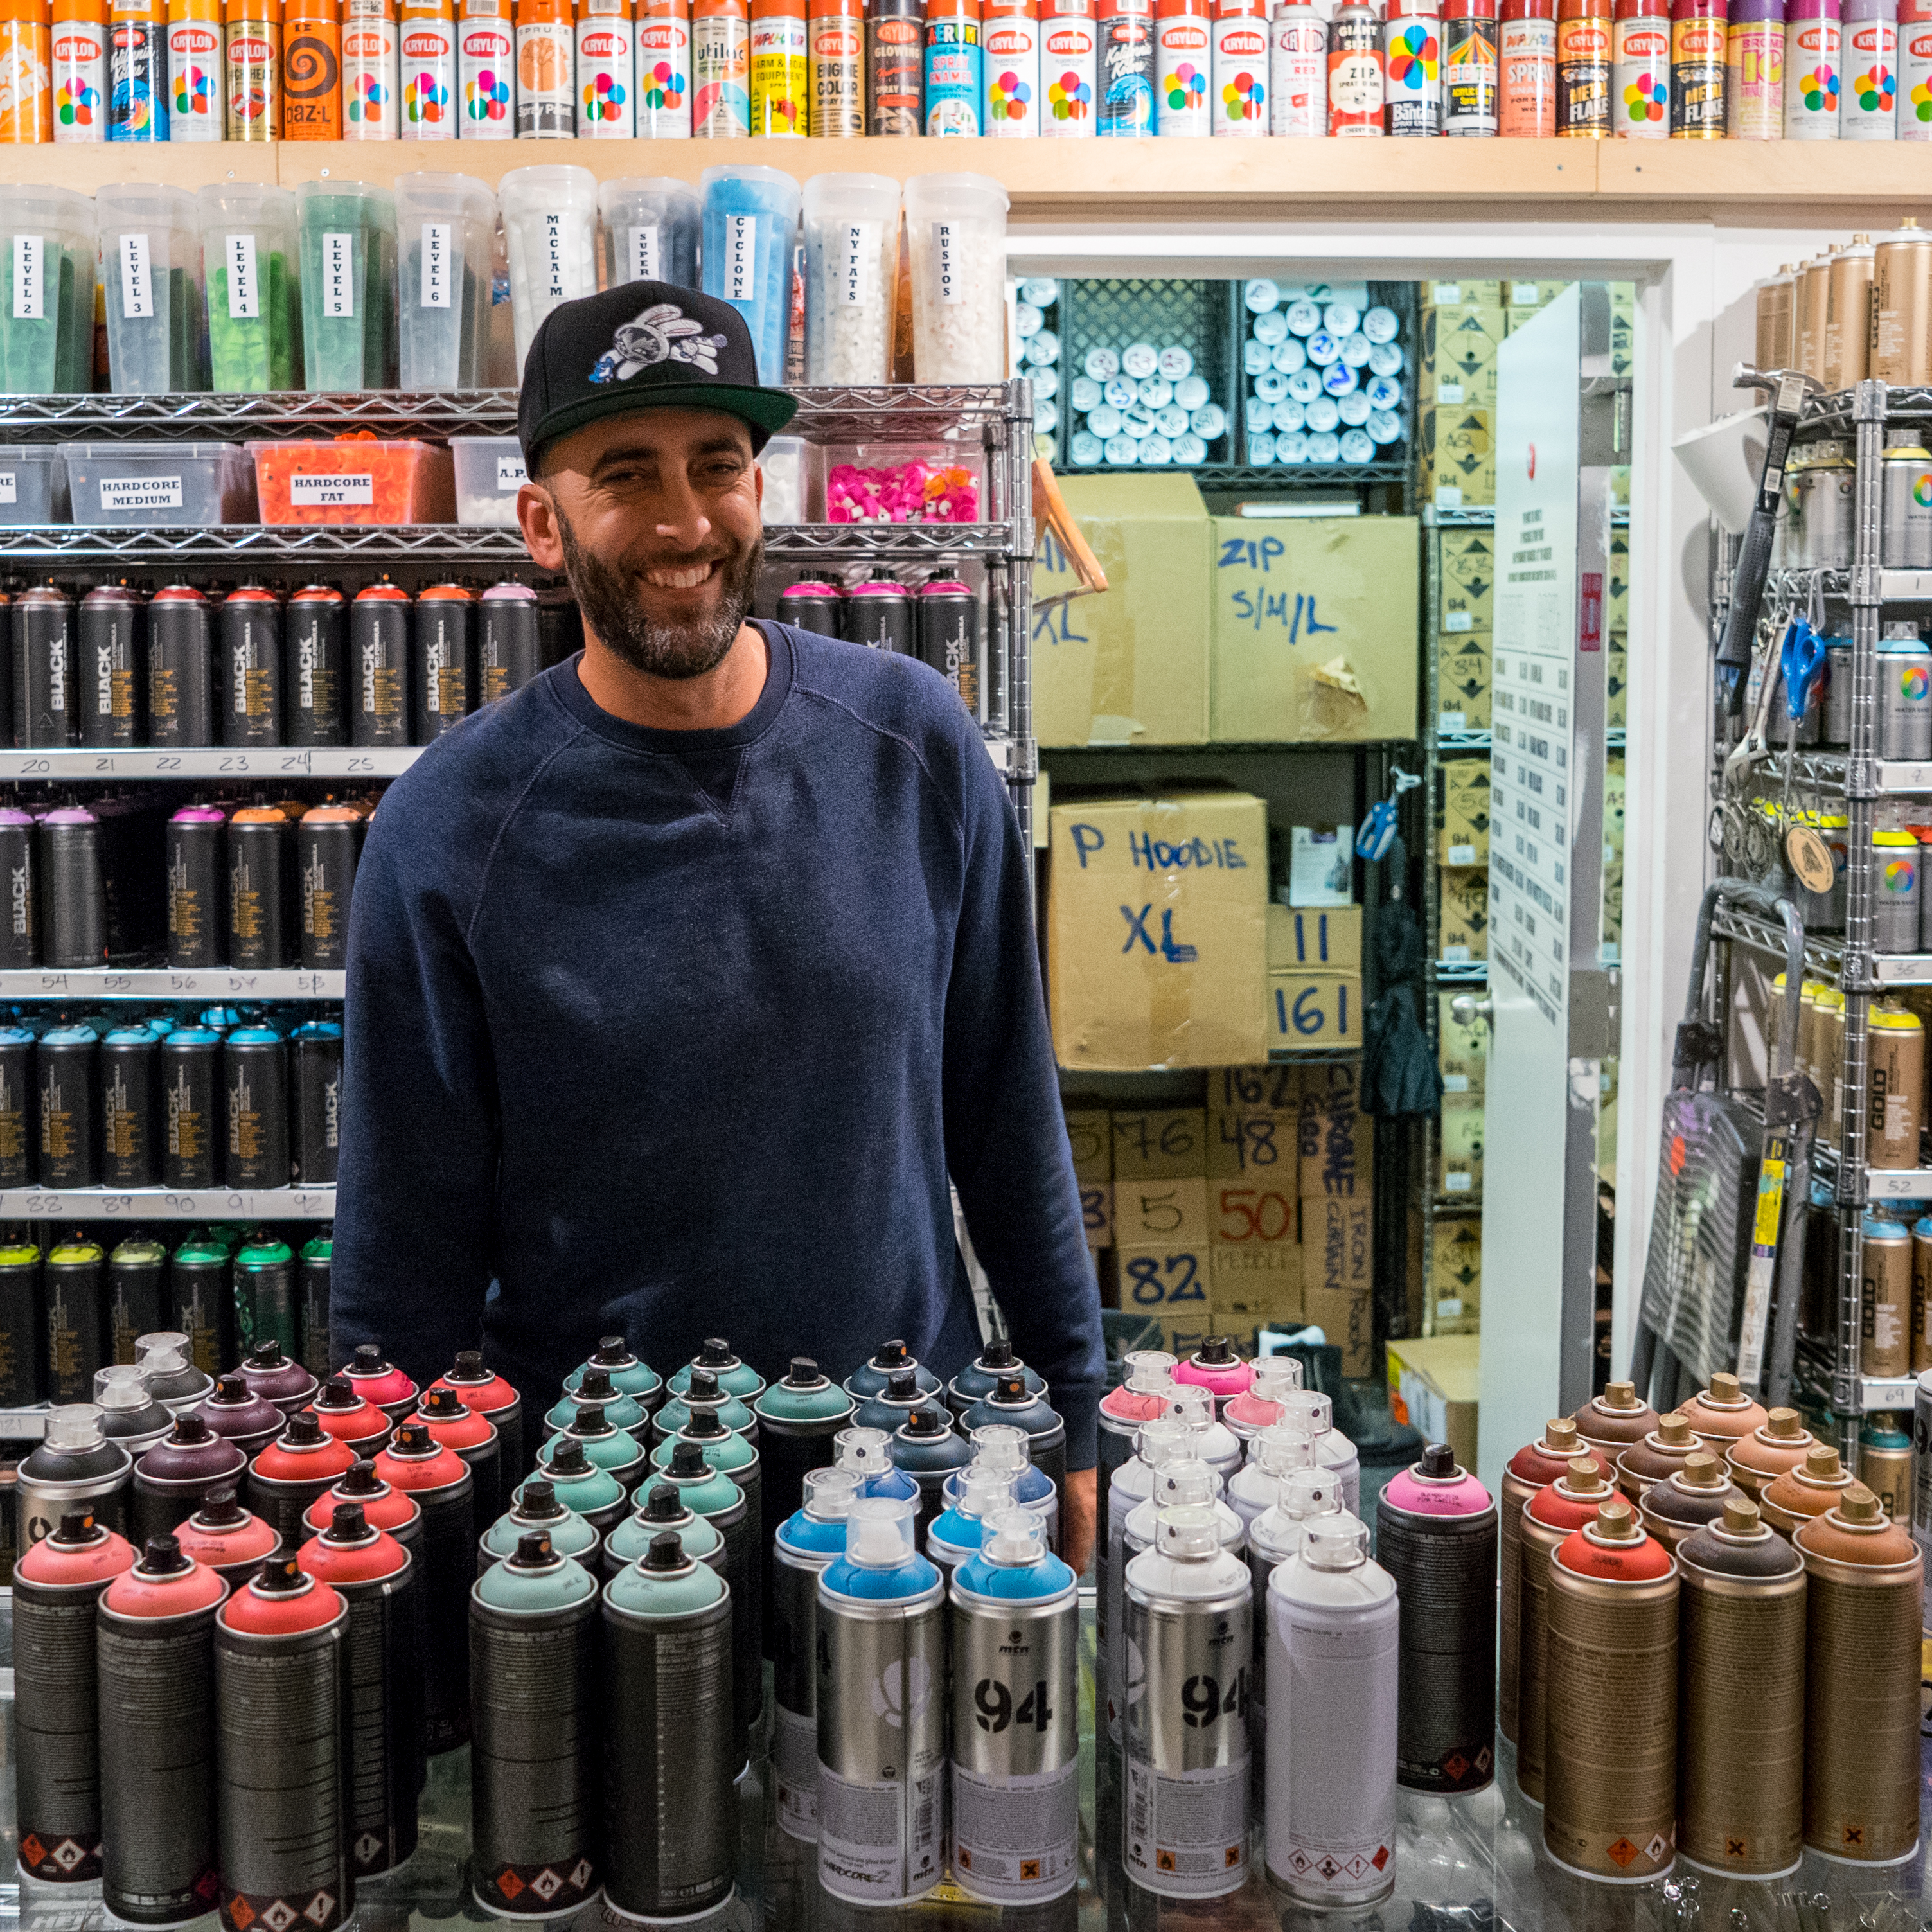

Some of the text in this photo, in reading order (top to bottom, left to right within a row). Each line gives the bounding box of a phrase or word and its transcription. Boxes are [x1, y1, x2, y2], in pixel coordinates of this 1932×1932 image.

[518, 26, 570, 37] SPRUCE
[644, 31, 682, 46] KRYLON
[1165, 32, 1205, 46] KRYLON
[1338, 25, 1378, 37] GIANT
[173, 35, 212, 48] KRYLON
[347, 40, 386, 52] KRYLON
[405, 39, 445, 53] KRYLON
[466, 38, 506, 53] KRYLON
[584, 39, 625, 52] KRYLON
[818, 38, 857, 53] KRYLON
[989, 36, 1028, 51] KRYLON
[1050, 37, 1089, 51] KRYLON
[1224, 37, 1263, 51] KRYLON
[1344, 40, 1373, 50] SIZE
[1568, 35, 1605, 48] KRYLON
[1626, 38, 1665, 52] KRYLON
[56, 42, 96, 58] KRYLON
[231, 45, 269, 58] KRYLON
[698, 42, 744, 60] utilac
[874, 46, 920, 59] GLOWING
[777, 58, 784, 68] &
[817, 63, 858, 78] ENGINE
[932, 55, 970, 71] SPRAY
[1294, 66, 1316, 75] RED
[756, 71, 804, 82] EQUIPMENT
[929, 71, 974, 86] ENAMEL
[1349, 67, 1376, 80] ZIP
[1450, 67, 1471, 82] BIG
[1507, 63, 1554, 84] SPRAY
[817, 81, 858, 96] COLOR
[546, 104, 571, 117] Paint
[1570, 97, 1609, 123] FLAKE
[1685, 98, 1724, 123] FLAKE
[545, 215, 563, 296] MACLAIM
[639, 233, 650, 276] SUPER
[734, 217, 745, 299] CYCLONE
[939, 226, 951, 297] RUSTOS
[431, 228, 441, 302] LEVEL 6
[23, 242, 32, 314] LEVEL 2
[129, 240, 142, 314] LEVEL 3
[235, 240, 248, 314] LEVEL 4
[333, 239, 342, 312] LEVEL 5
[102, 480, 180, 492] HARDCORE
[294, 477, 371, 489] HARDCORE
[112, 493, 172, 506] MEDIUM
[320, 492, 346, 502] FAT
[1217, 536, 1285, 572] ZIP
[1230, 586, 1339, 645] S/M/L
[49, 639, 64, 711] BLACK
[98, 646, 112, 714] BLACK
[234, 644, 247, 713] BLACK
[299, 637, 314, 709] BLACK
[362, 644, 375, 713] BLACK
[427, 643, 439, 711] BLACK
[20, 759, 51, 774] 20
[96, 758, 114, 772] 21
[155, 756, 182, 770] 22
[218, 756, 249, 772] 23
[347, 758, 375, 772] 25
[1069, 823, 1248, 871] P HOODIE
[12, 866, 27, 935] BLACK
[304, 866, 314, 933] BLACK
[1119, 903, 1198, 964] XL
[1295, 913, 1329, 962] 11
[1893, 962, 1920, 977] 35
[41, 975, 68, 990] 54
[105, 976, 132, 990] 55
[171, 976, 197, 990] 56
[1275, 984, 1347, 1034] 161
[1871, 1068, 1886, 1130] GOLD
[168, 1088, 180, 1155] BLACK
[229, 1088, 240, 1155] BLACK
[326, 1080, 339, 1148] BLACK
[1116, 1117, 1195, 1161] 76
[1219, 1117, 1279, 1171] 48
[1886, 1180, 1912, 1193] 52
[26, 1196, 63, 1213] 88
[102, 1195, 133, 1213] 89
[165, 1194, 195, 1213] 90
[227, 1194, 254, 1214] 91
[294, 1194, 324, 1214] 92
[1140, 1191, 1183, 1232] 5
[1220, 1189, 1291, 1241] 50
[1349, 1205, 1367, 1279] IRON
[1126, 1254, 1207, 1306] 82
[1863, 1278, 1875, 1338] GOLD
[1885, 1388, 1904, 1403] 69
[998, 1645, 1030, 1654] mtn
[975, 1678, 1053, 1733] 94
[1180, 1667, 1248, 1728] 94
[913, 1866, 934, 1881] mtn
